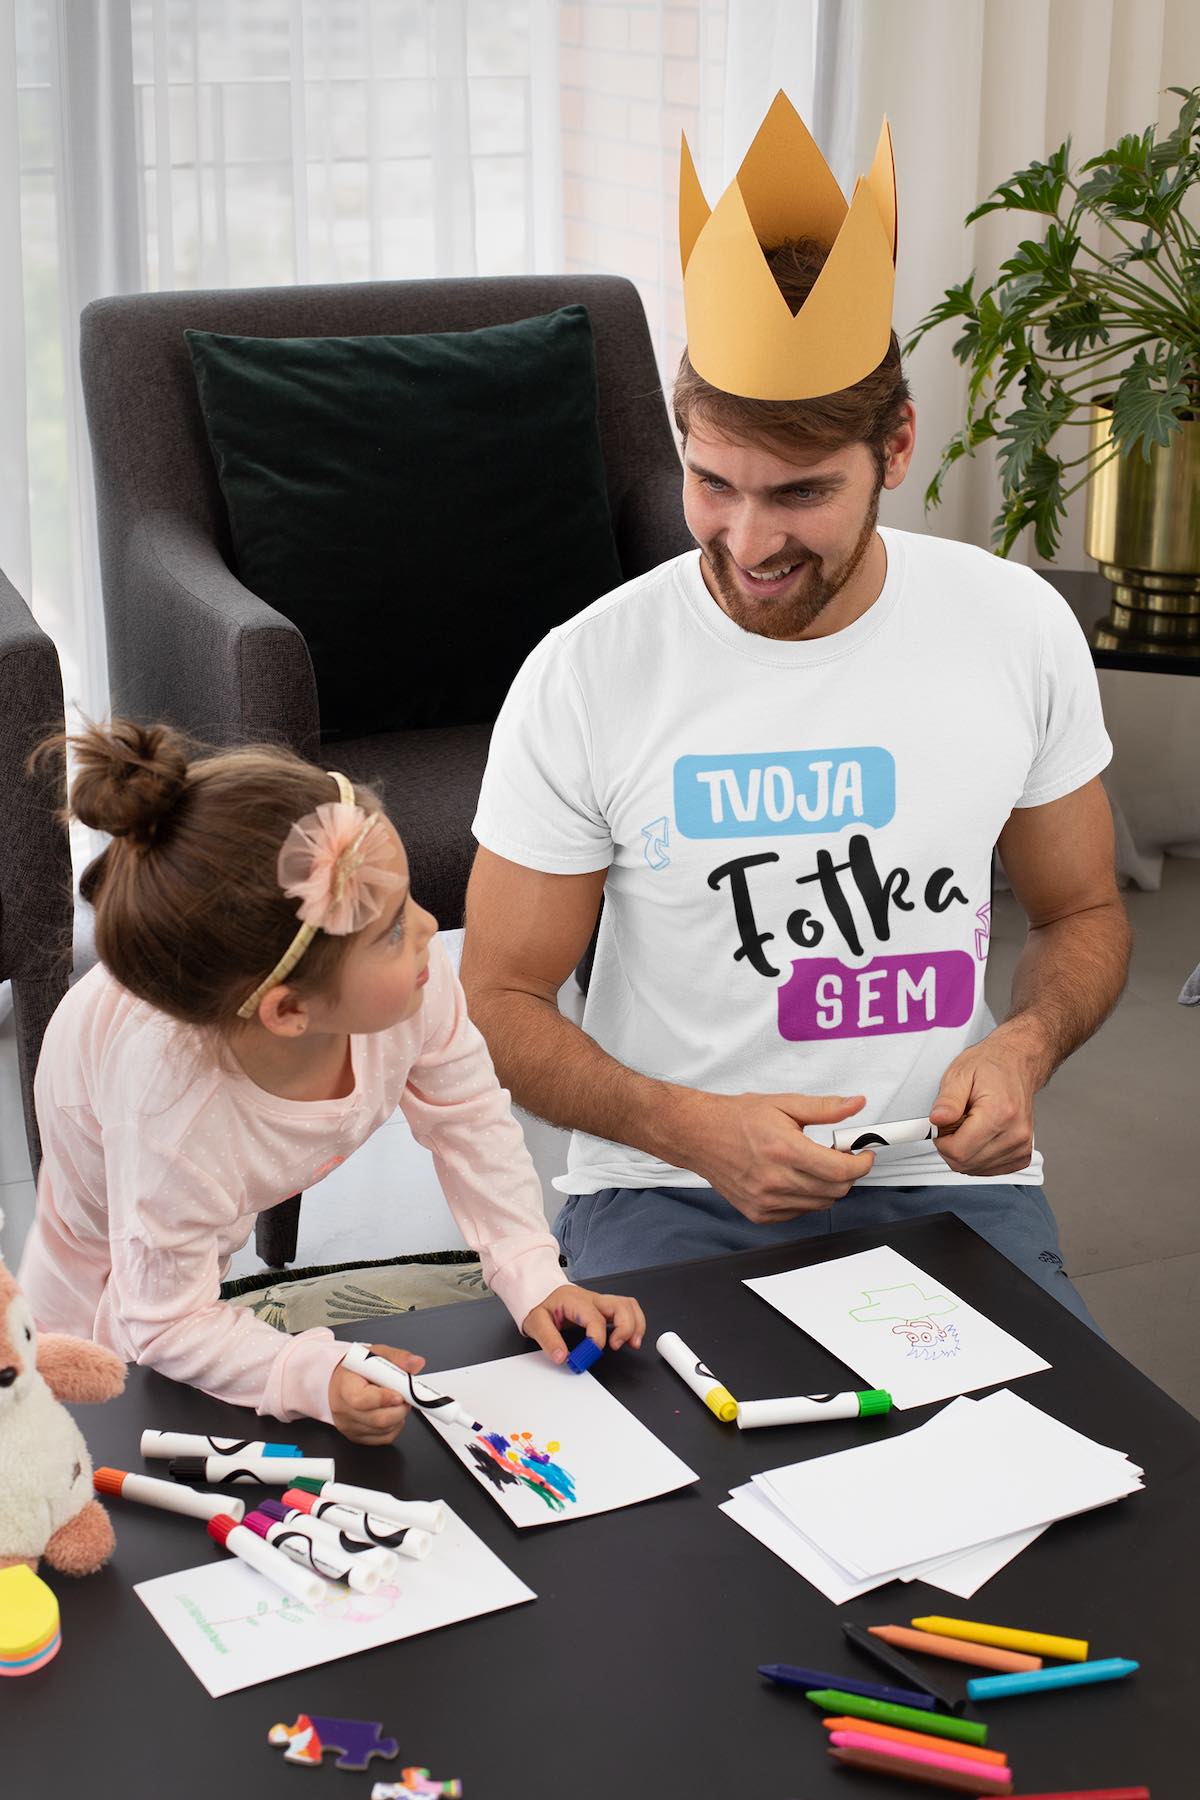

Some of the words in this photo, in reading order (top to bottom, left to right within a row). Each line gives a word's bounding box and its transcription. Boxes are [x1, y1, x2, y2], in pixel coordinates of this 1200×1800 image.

[696, 760, 864, 824] TVOJA
[706, 834, 969, 977] Fotka
[814, 965, 937, 1030] SEM
